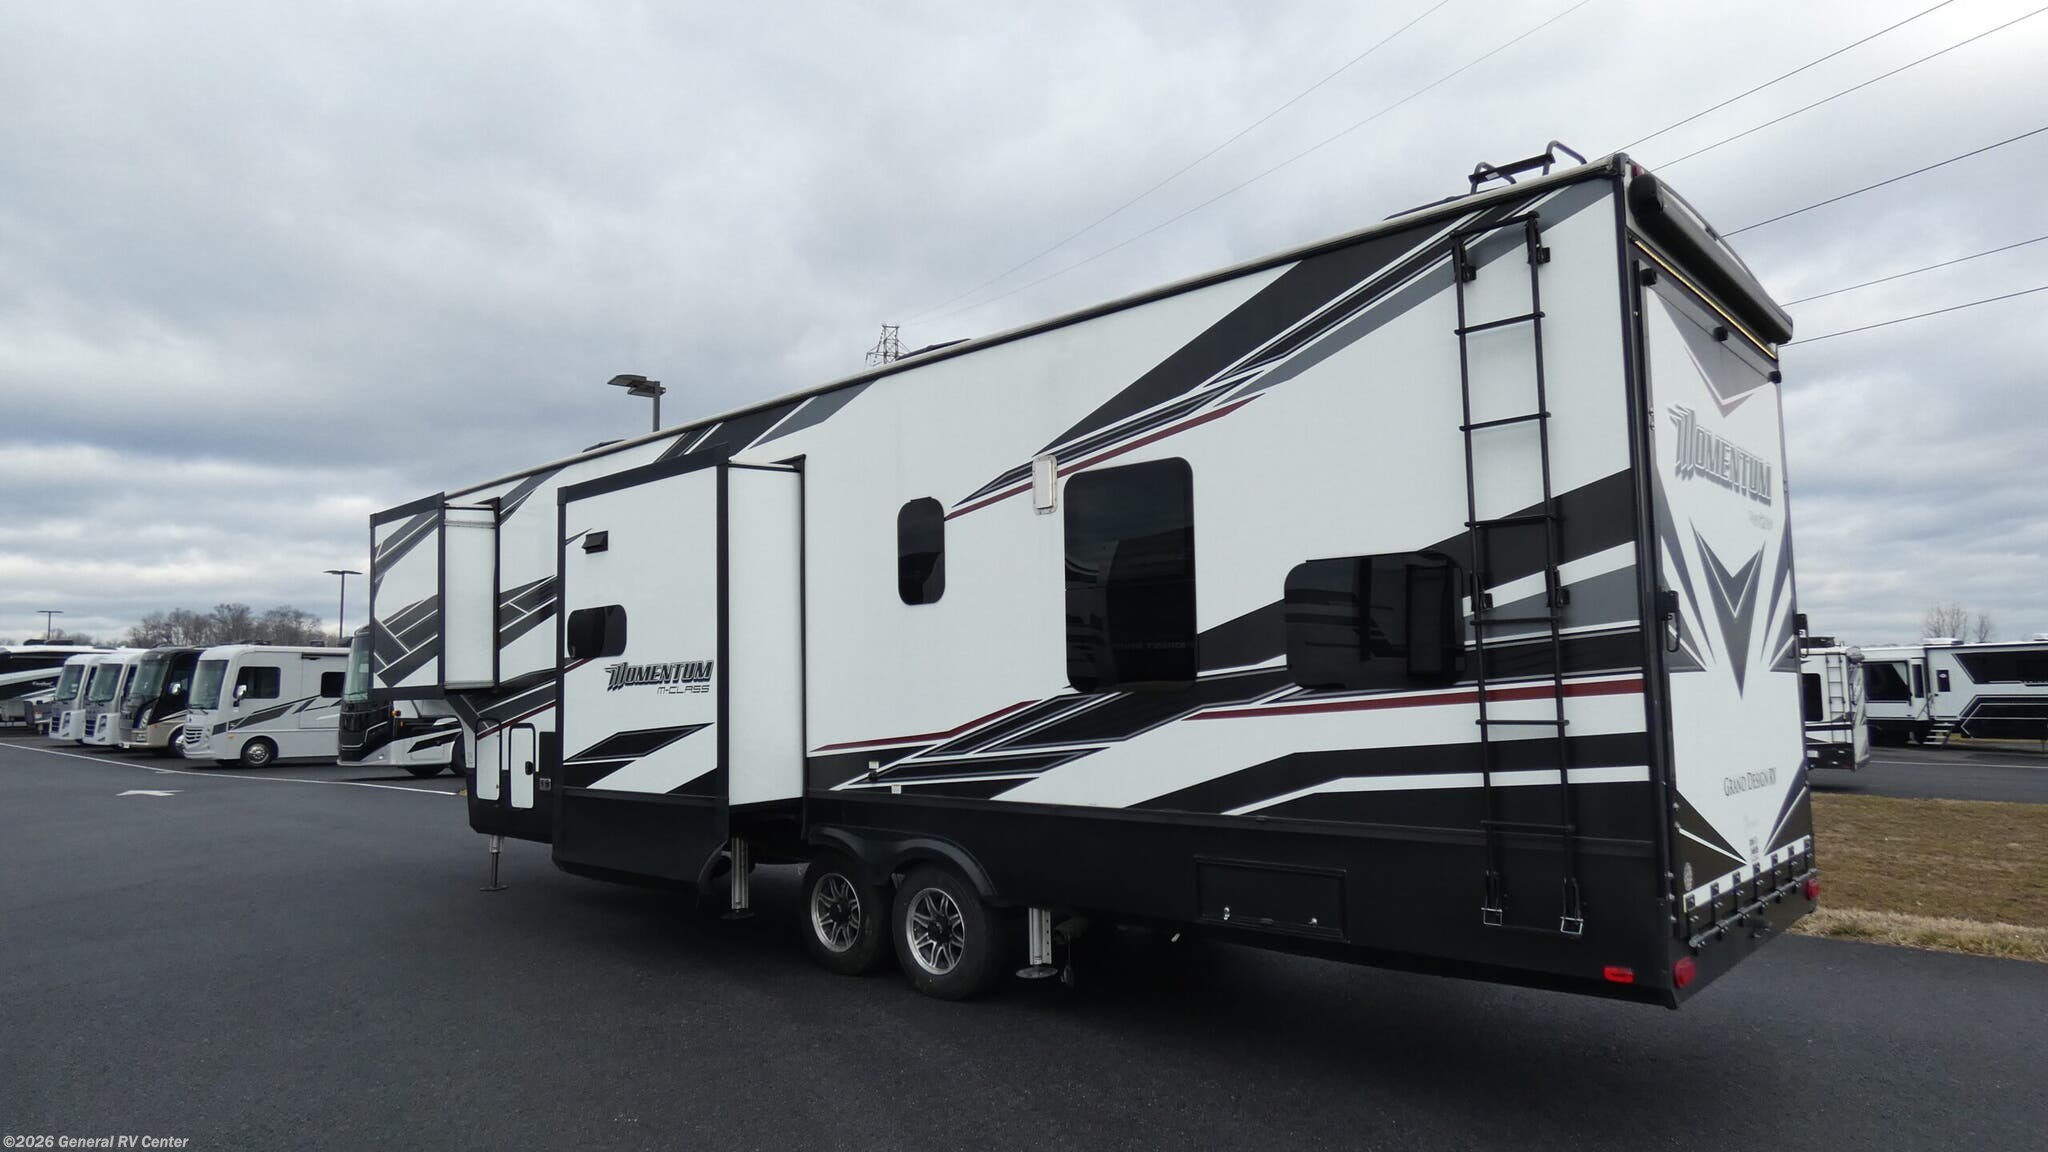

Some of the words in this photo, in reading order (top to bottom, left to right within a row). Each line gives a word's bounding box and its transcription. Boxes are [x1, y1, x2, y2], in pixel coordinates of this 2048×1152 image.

[1667, 404, 1772, 507] MOMENTUM
[604, 660, 715, 692] MOMENTUM
[656, 684, 710, 695] M-CLASS
